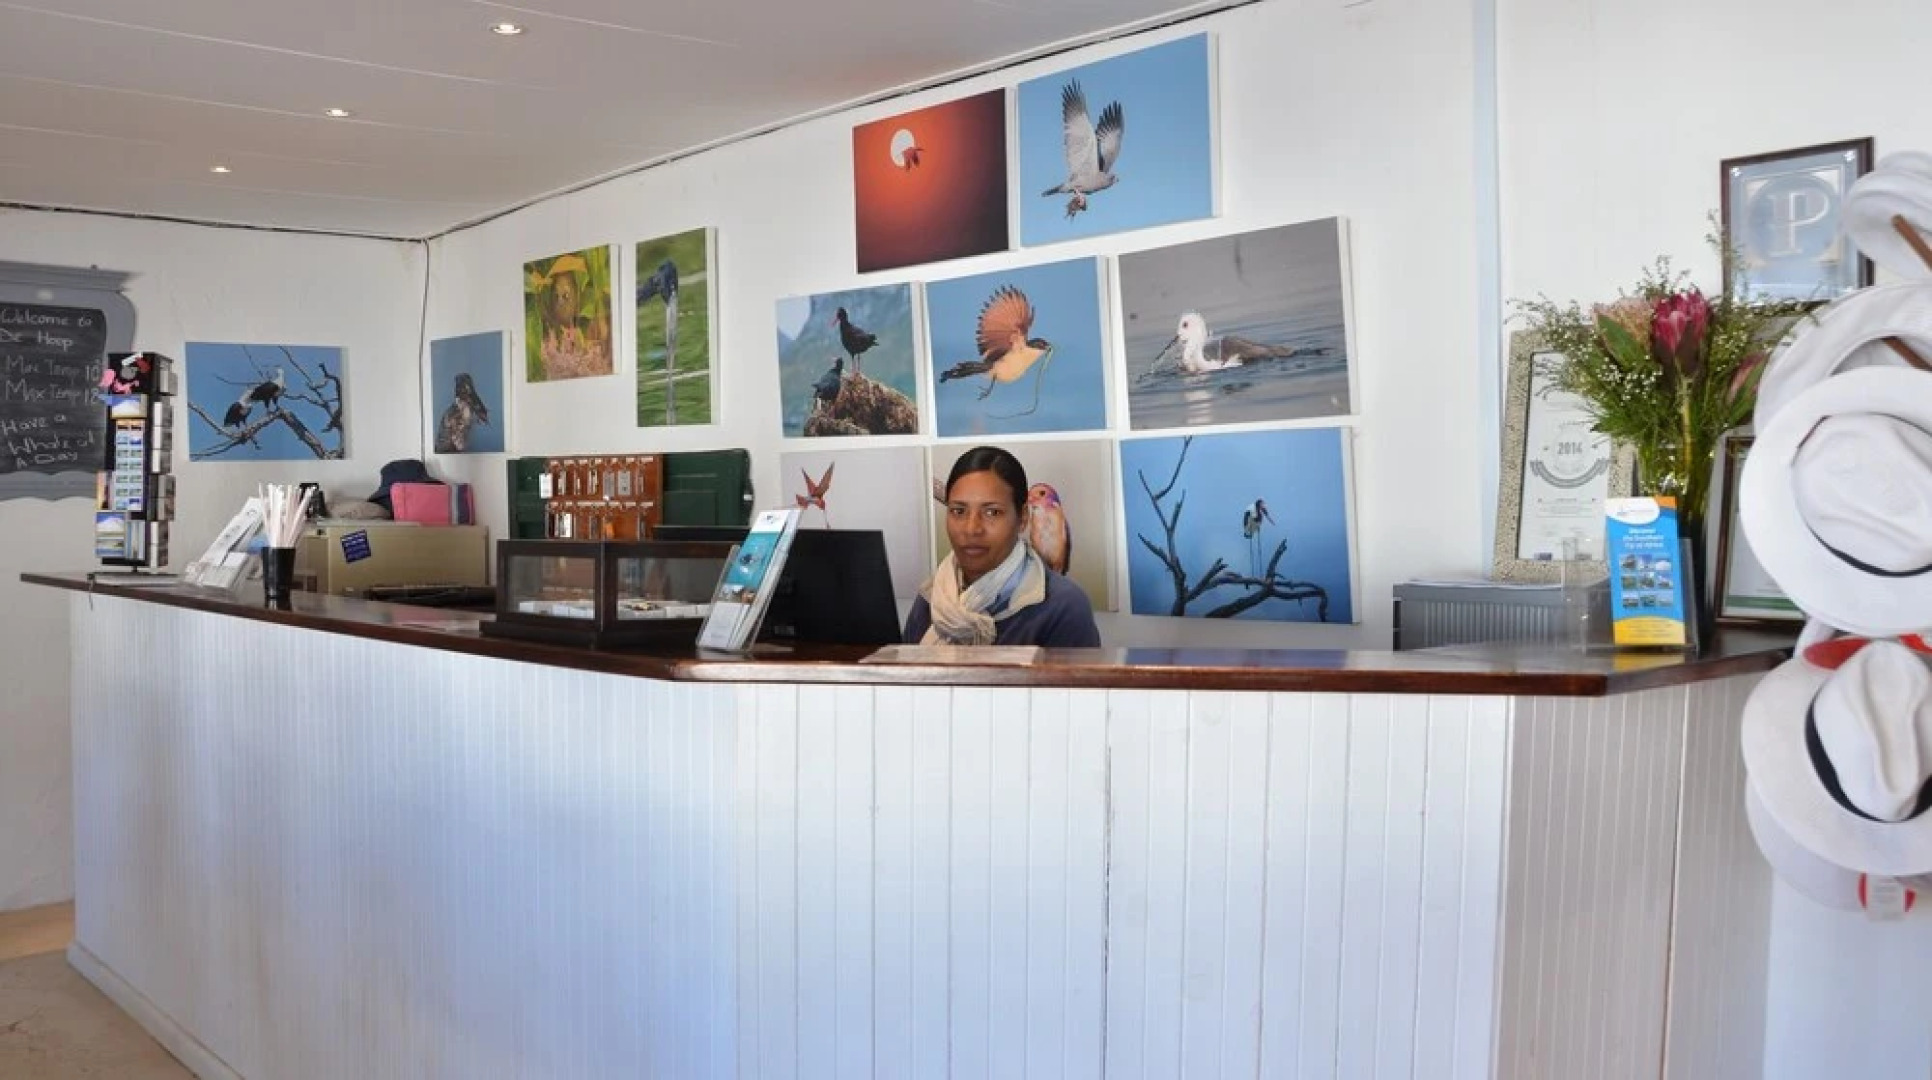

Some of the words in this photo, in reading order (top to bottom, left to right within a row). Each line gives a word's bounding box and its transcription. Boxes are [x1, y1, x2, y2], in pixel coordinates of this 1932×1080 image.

[0, 308, 69, 326] Welcome
[38, 330, 74, 352] Hoop
[1, 416, 49, 437] Have
[1556, 441, 1584, 456] 2014
